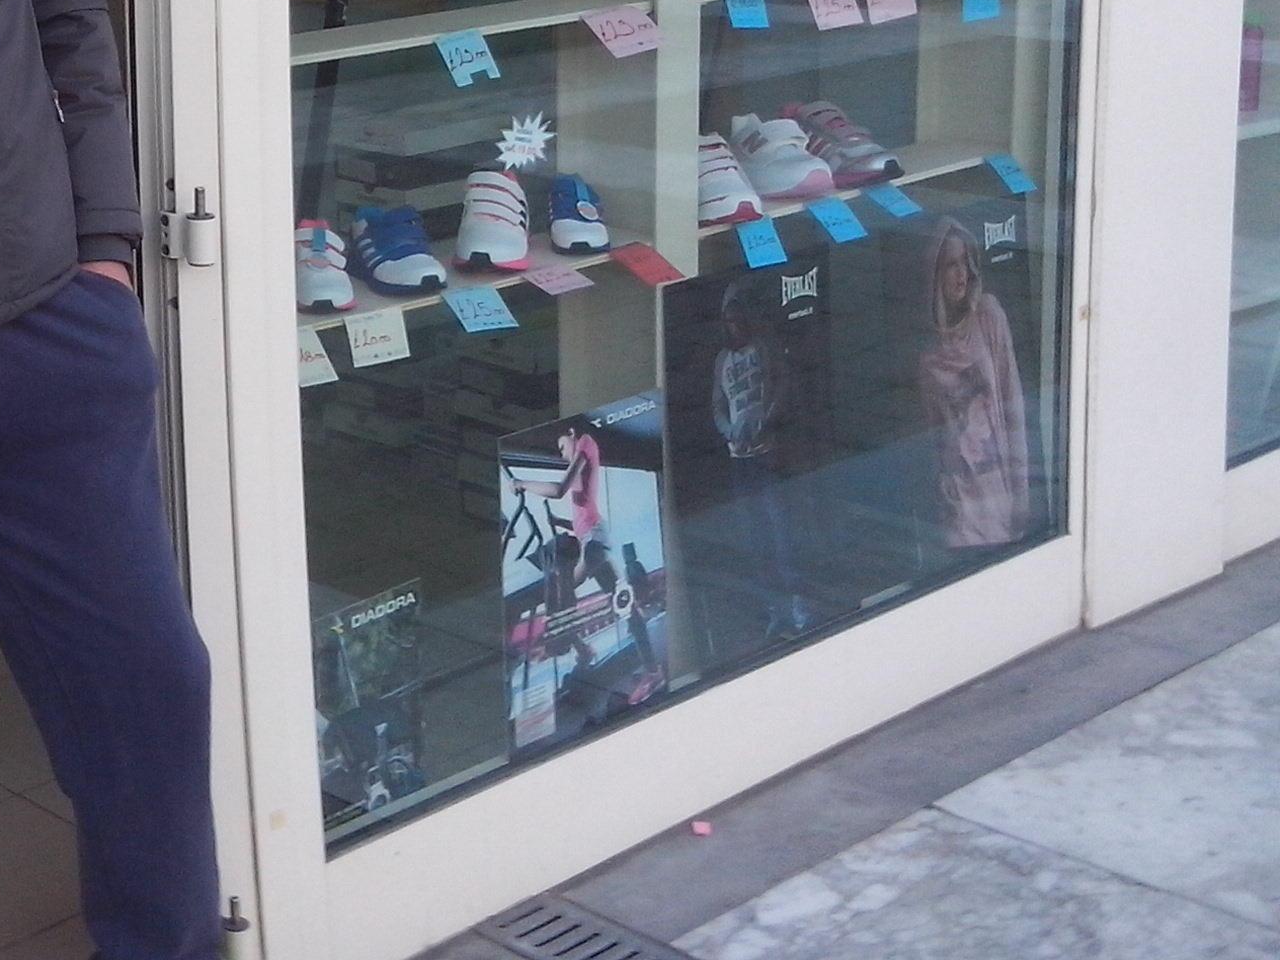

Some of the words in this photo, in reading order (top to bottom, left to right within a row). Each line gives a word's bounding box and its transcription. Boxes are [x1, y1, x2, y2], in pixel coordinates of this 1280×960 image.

[781, 266, 818, 307] EVERLAST
[606, 400, 656, 424] DIADORA
[351, 592, 416, 628] DIADORA
